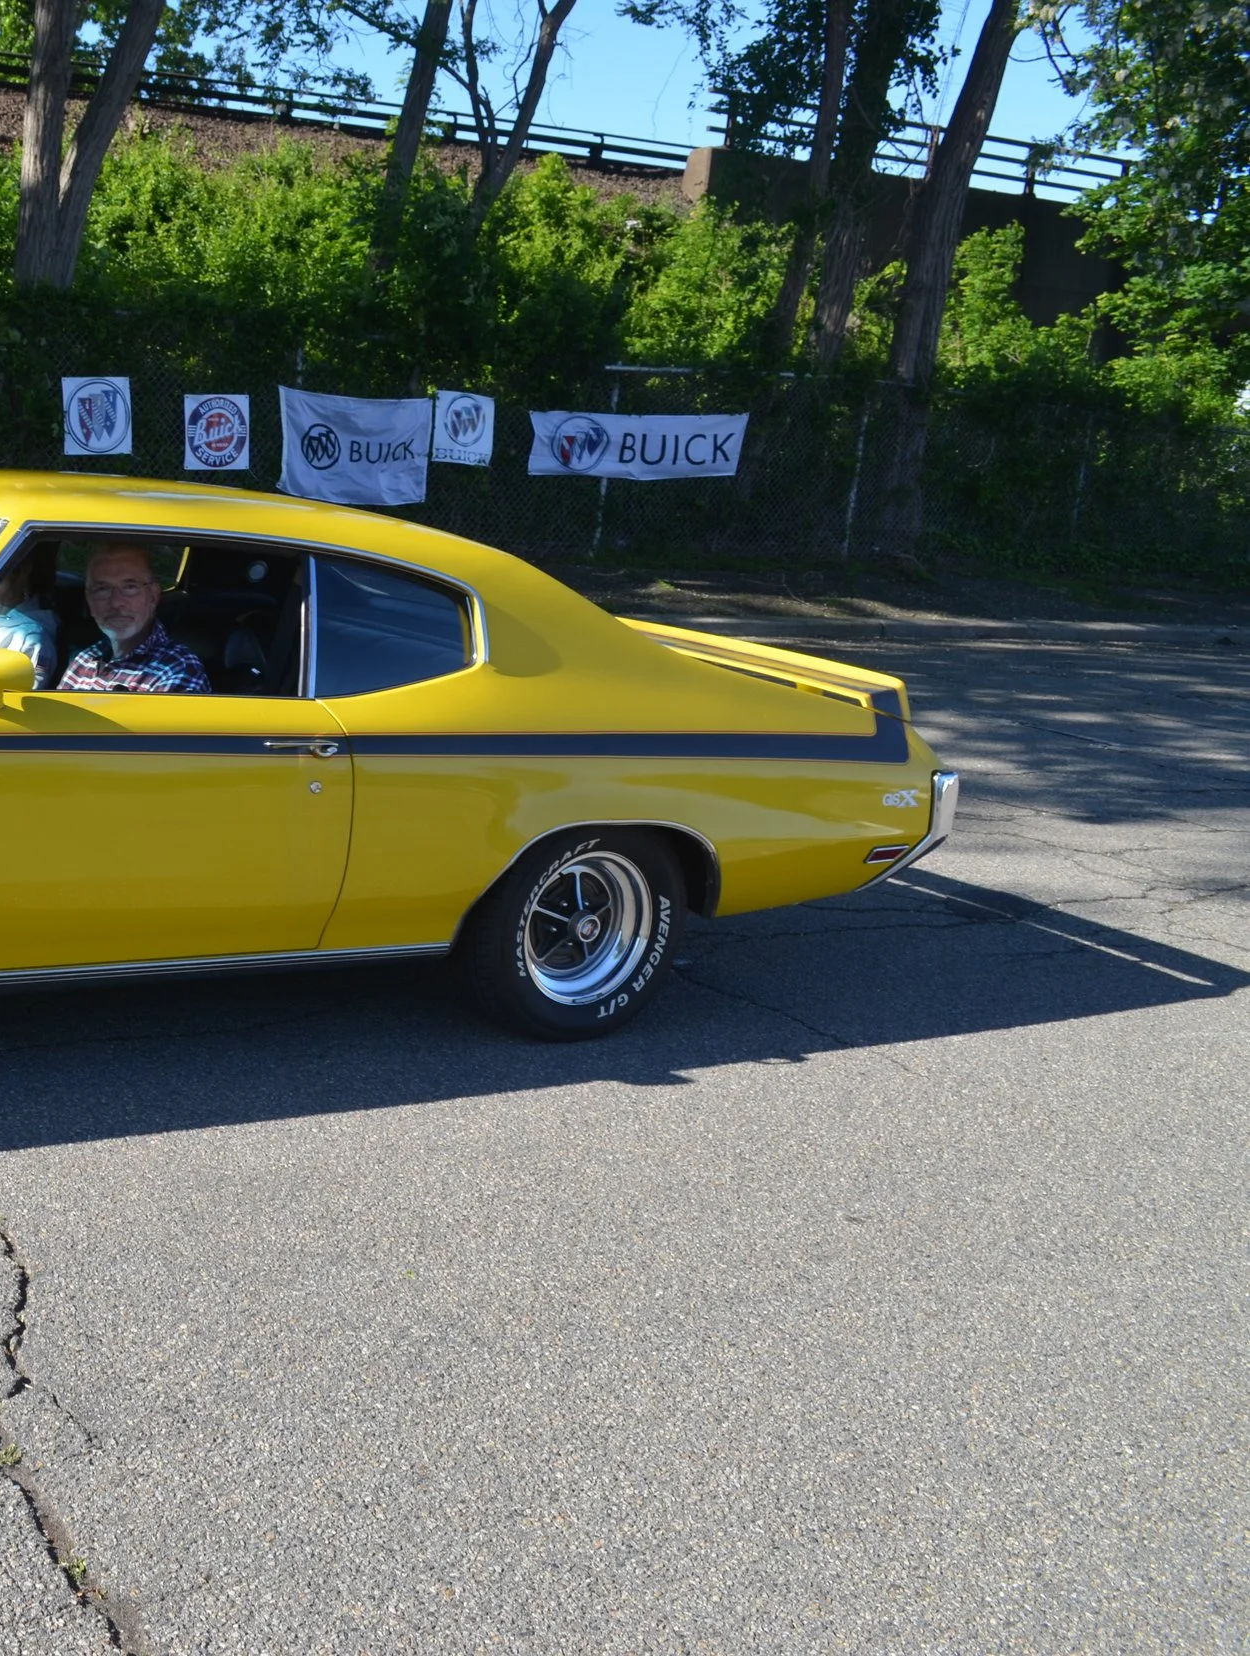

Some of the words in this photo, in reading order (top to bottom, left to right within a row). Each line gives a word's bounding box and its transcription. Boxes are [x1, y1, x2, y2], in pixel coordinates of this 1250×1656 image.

[198, 398, 238, 415] AUTHORIZED
[193, 414, 243, 446] Buick
[195, 447, 239, 466] SERVICE
[350, 438, 415, 463] BUICK
[434, 448, 489, 464] BUICK
[619, 432, 735, 466] BUICK
[882, 789, 918, 808] GSX
[516, 838, 601, 977] MASTERCRAFT
[632, 895, 671, 992] AVENGER
[597, 992, 630, 1019] G/T
